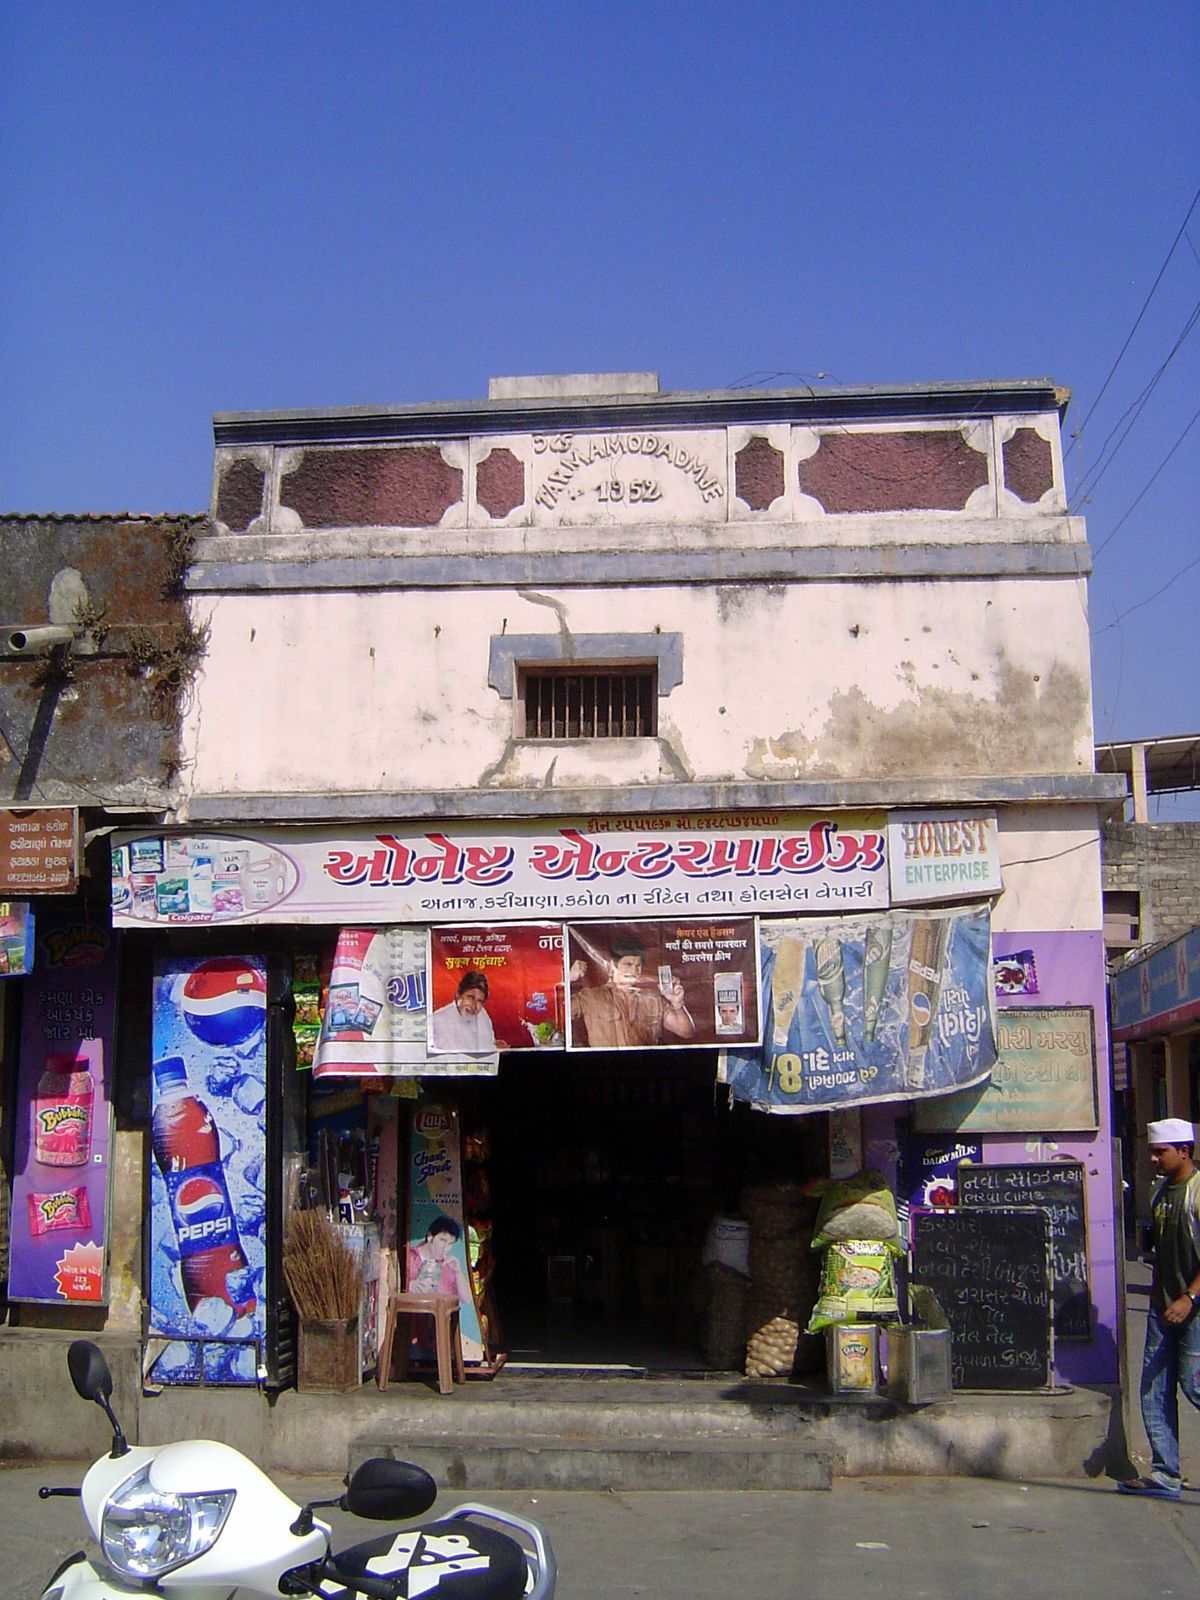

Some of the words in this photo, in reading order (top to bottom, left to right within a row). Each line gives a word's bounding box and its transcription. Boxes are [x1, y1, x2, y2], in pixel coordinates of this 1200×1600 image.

[595, 479, 663, 503] 1952
[901, 819, 991, 859] HONEST
[323, 833, 514, 886] ઓનેષ્ટ
[528, 820, 885, 881] એન્ટરપ્રાઈઝ
[905, 861, 989, 884] ENTERPRISE
[616, 892, 636, 905] ના
[643, 888, 689, 905] રીટેલ
[696, 889, 734, 906] તથા
[739, 884, 809, 903] હોલસેલ
[815, 880, 873, 899] વેપારી
[171, 913, 211, 922] Colgate
[681, 939, 692, 949] की
[910, 959, 940, 983] PEPSI
[922, 1152, 950, 1166] DAIRY
[179, 1215, 233, 1243] PEPSI
